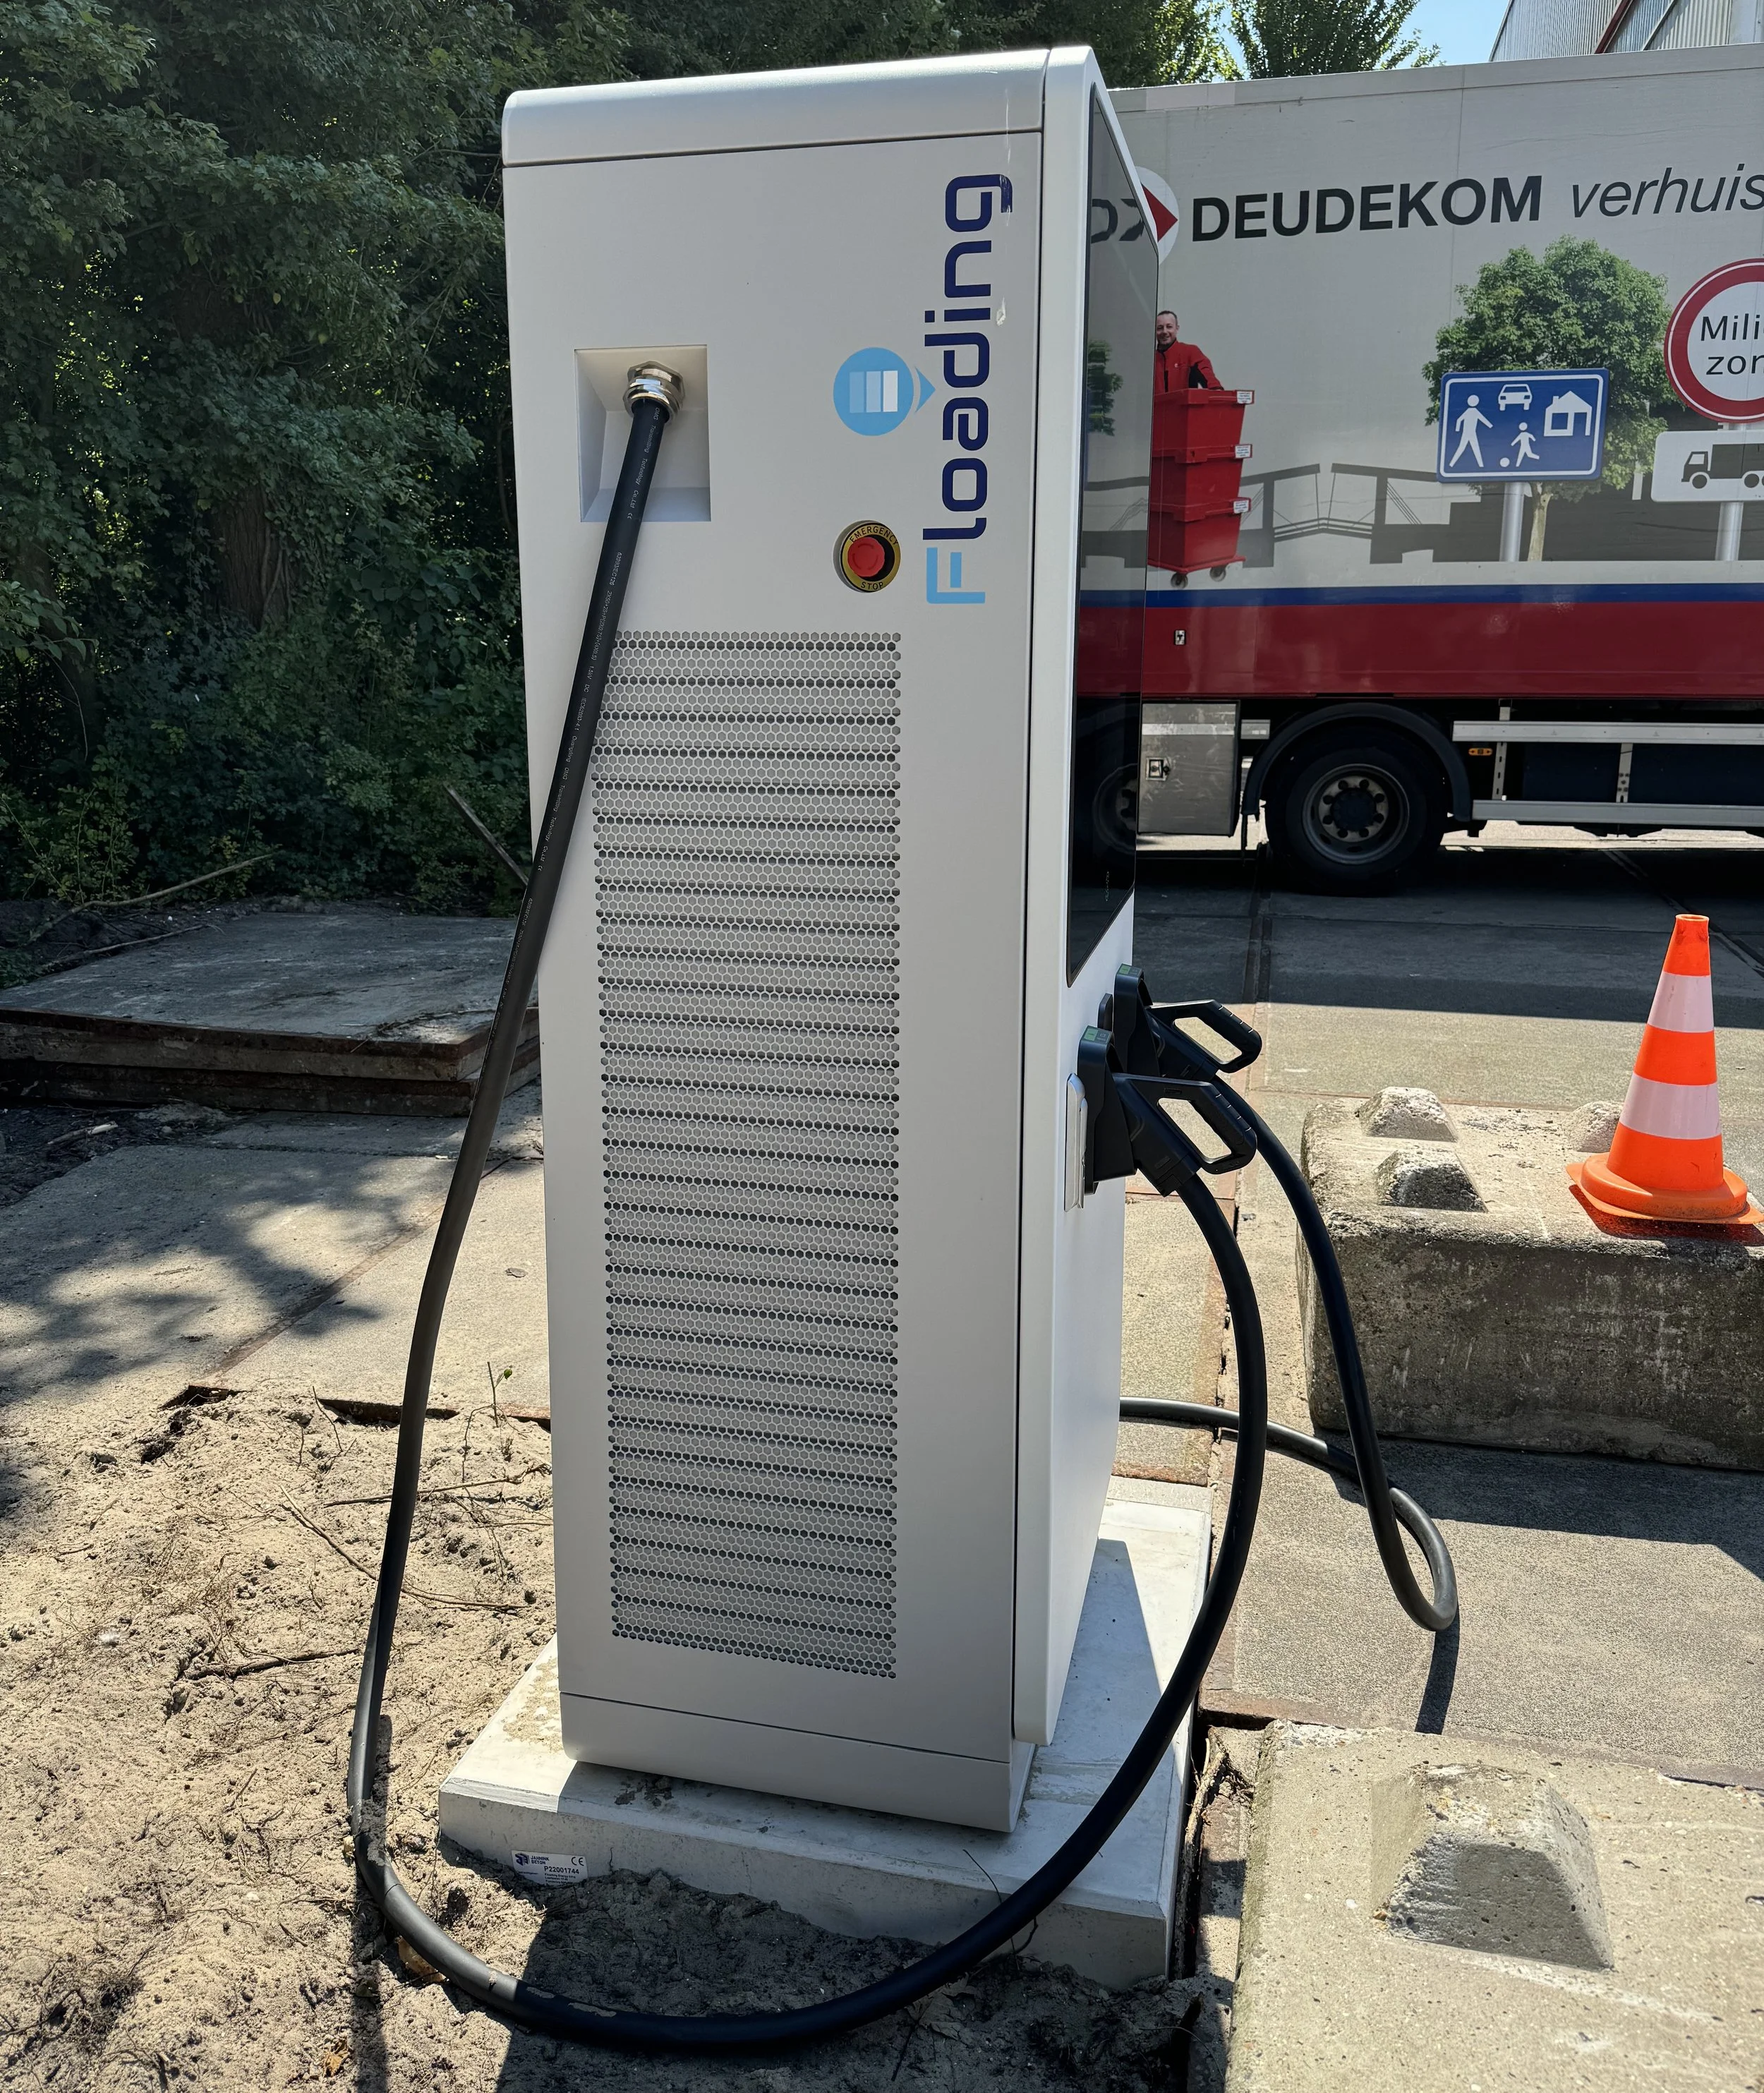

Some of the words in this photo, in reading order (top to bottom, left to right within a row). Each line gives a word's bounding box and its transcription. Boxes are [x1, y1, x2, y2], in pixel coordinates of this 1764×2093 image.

[1192, 175, 1542, 242] DEUDEKOM
[1571, 163, 1764, 217] verhuis
[1700, 313, 1764, 342] Mili
[923, 174, 1013, 604] Floading
[644, 425, 656, 453] Transmitting
[635, 457, 648, 485] Technology
[849, 526, 899, 545] EMERGENCY
[861, 581, 884, 590] STOP
[584, 684, 591, 693] DC
[543, 1866, 580, 1874] P22001744
